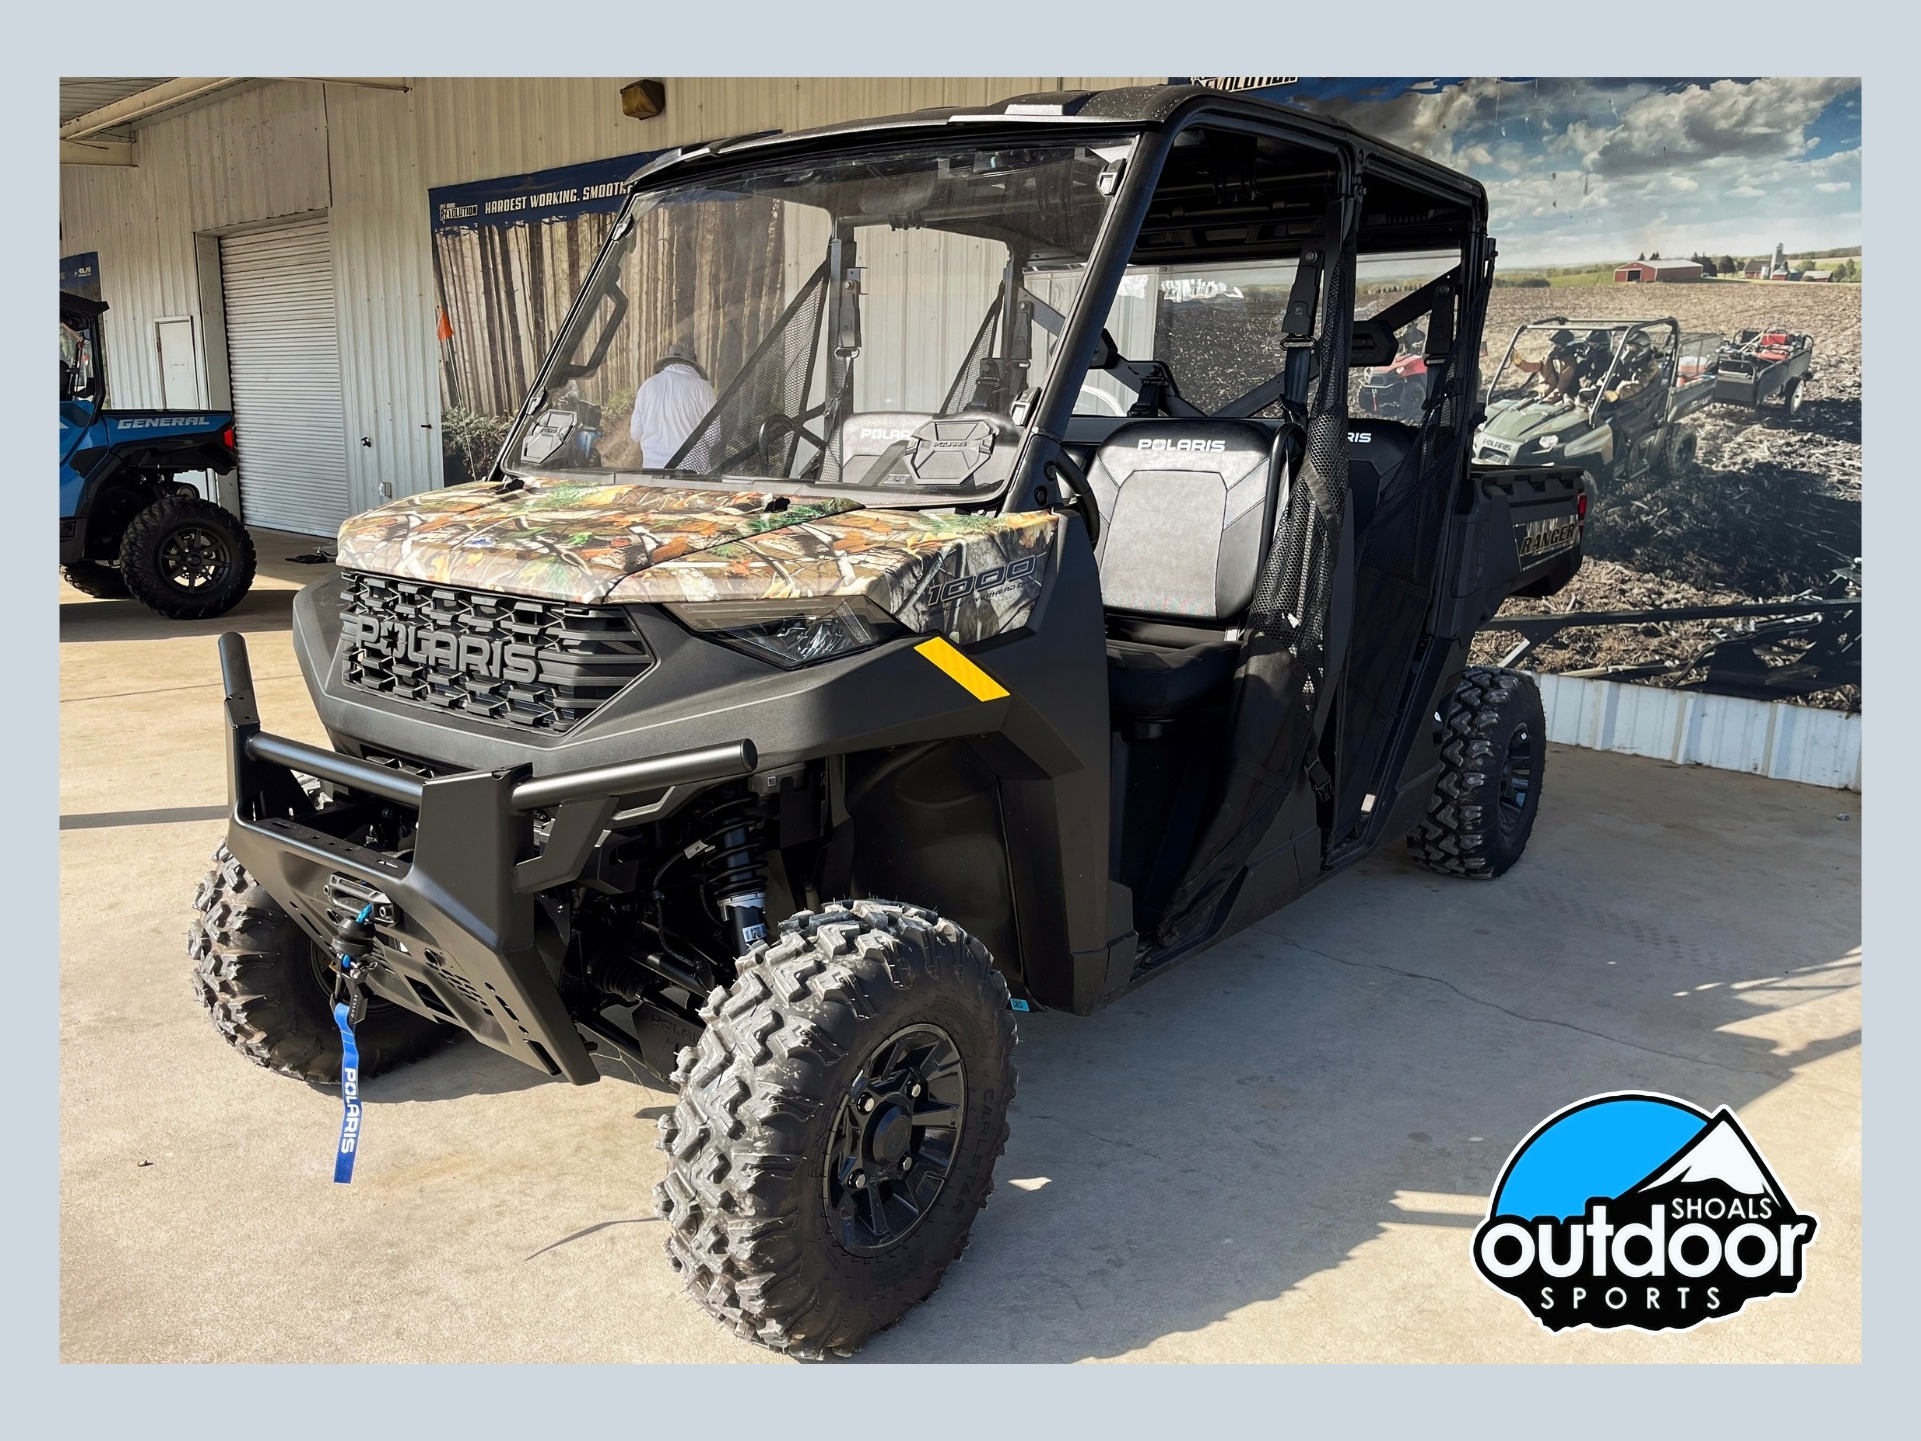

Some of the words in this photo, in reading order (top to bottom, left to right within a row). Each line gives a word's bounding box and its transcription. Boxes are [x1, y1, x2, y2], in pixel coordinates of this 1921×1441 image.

[485, 196, 528, 214] HARDEST
[530, 188, 580, 208] WORKING.
[117, 416, 210, 430] GENERAL
[860, 428, 914, 441] POLAR
[1137, 438, 1226, 452] POLARIS
[1520, 523, 1576, 557] RANGER
[928, 554, 1037, 607] 1000
[356, 614, 539, 684] POLARIS
[341, 1067, 360, 1154] POLARIS
